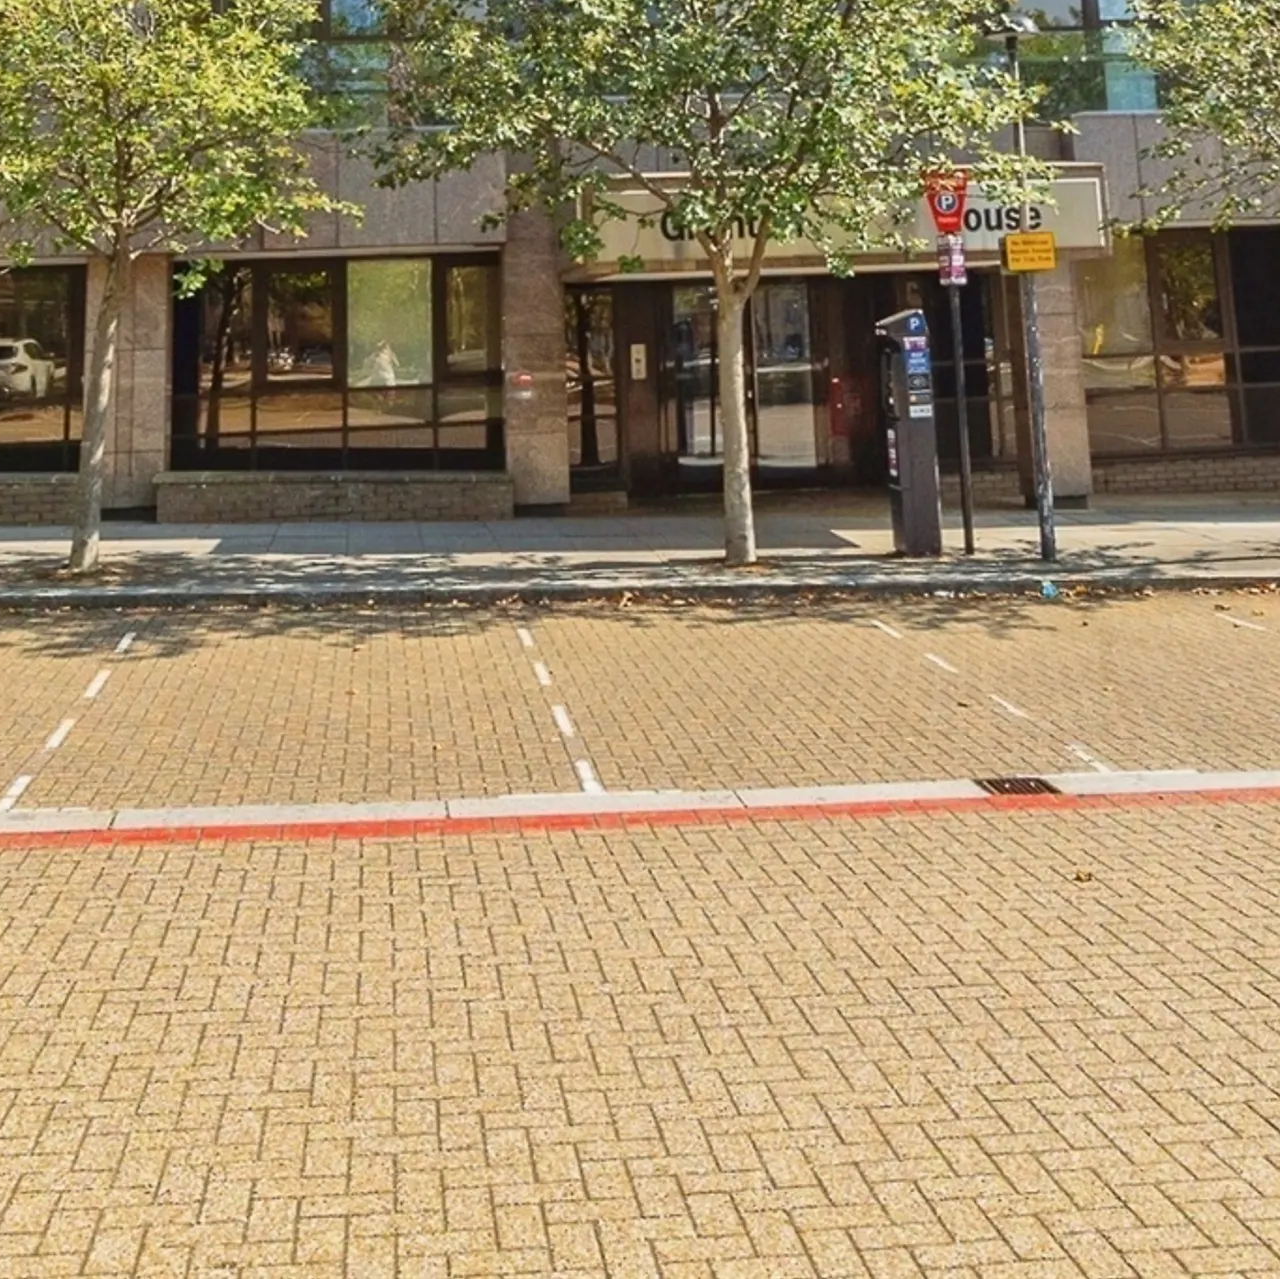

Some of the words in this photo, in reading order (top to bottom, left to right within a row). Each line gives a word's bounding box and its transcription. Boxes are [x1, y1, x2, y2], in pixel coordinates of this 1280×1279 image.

[941, 195, 954, 210] P
[963, 206, 1042, 232] ouse
[910, 318, 920, 330] P
